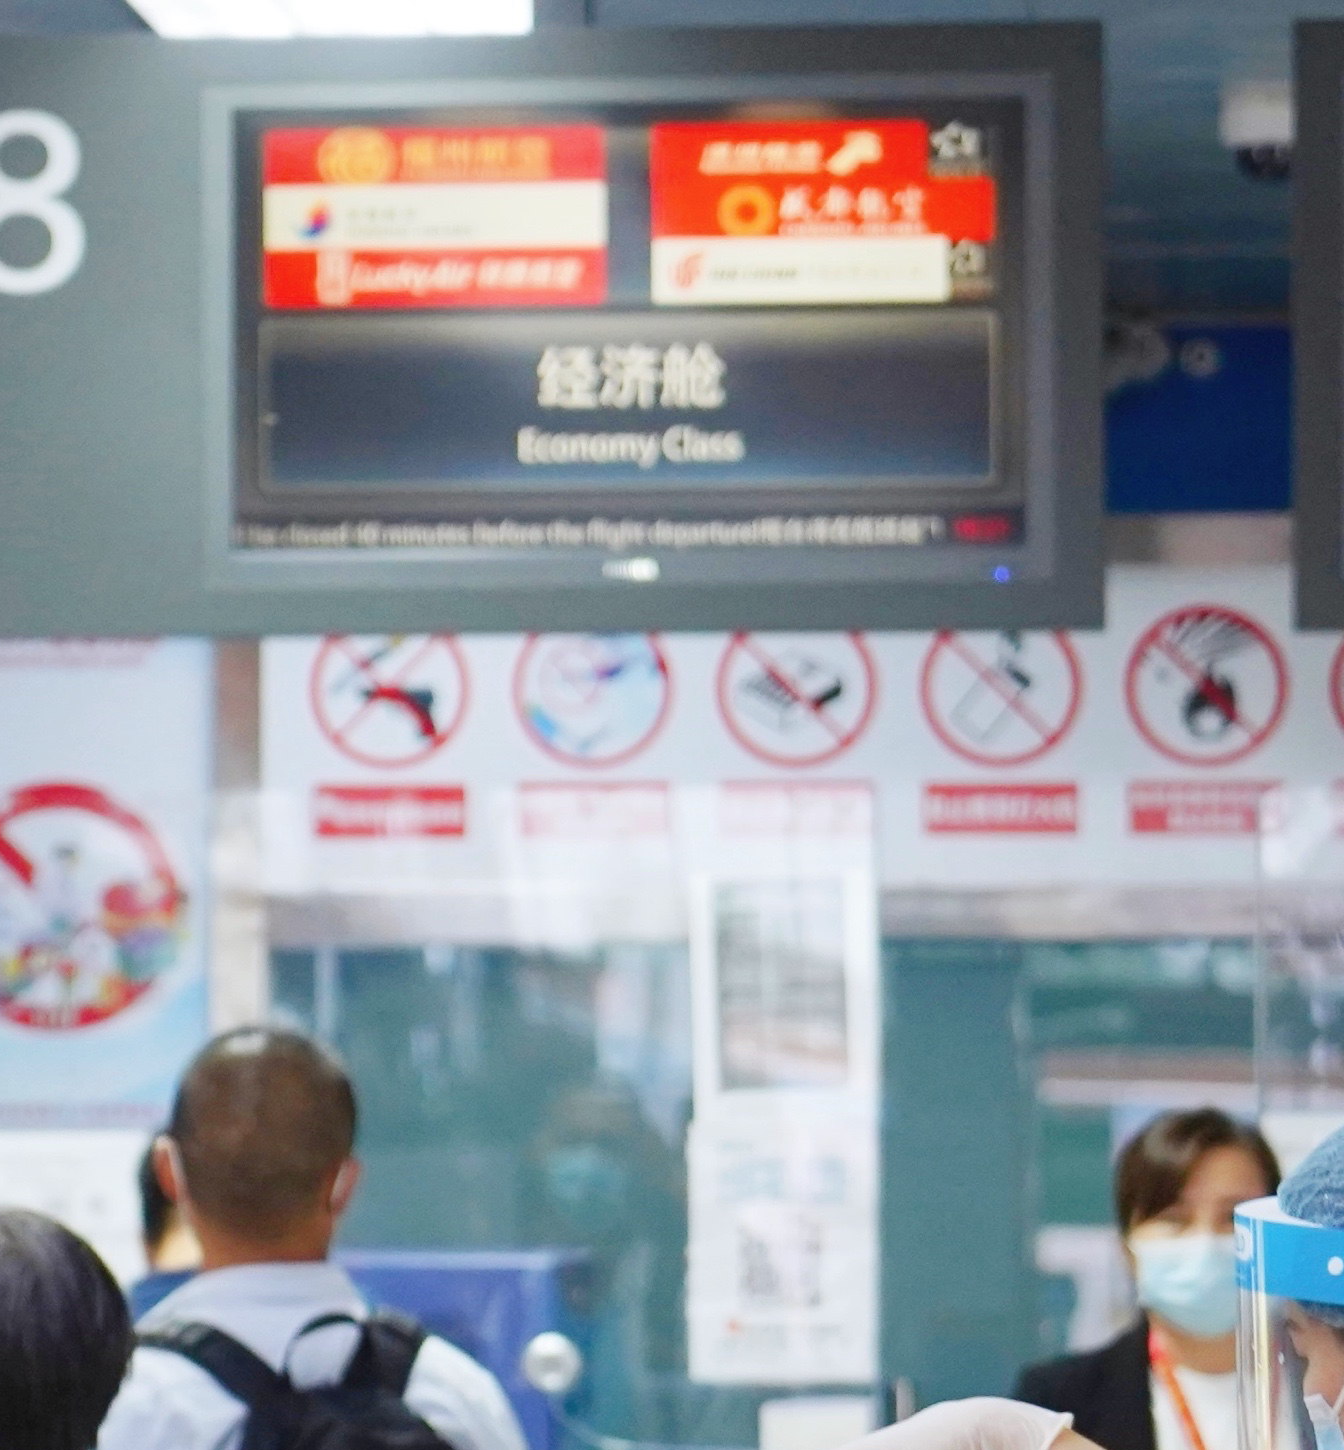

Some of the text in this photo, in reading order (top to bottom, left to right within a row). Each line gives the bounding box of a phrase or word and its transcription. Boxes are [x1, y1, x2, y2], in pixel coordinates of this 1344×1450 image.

[537, 342, 727, 410] 经济舱
[517, 424, 746, 469] Economy Class
